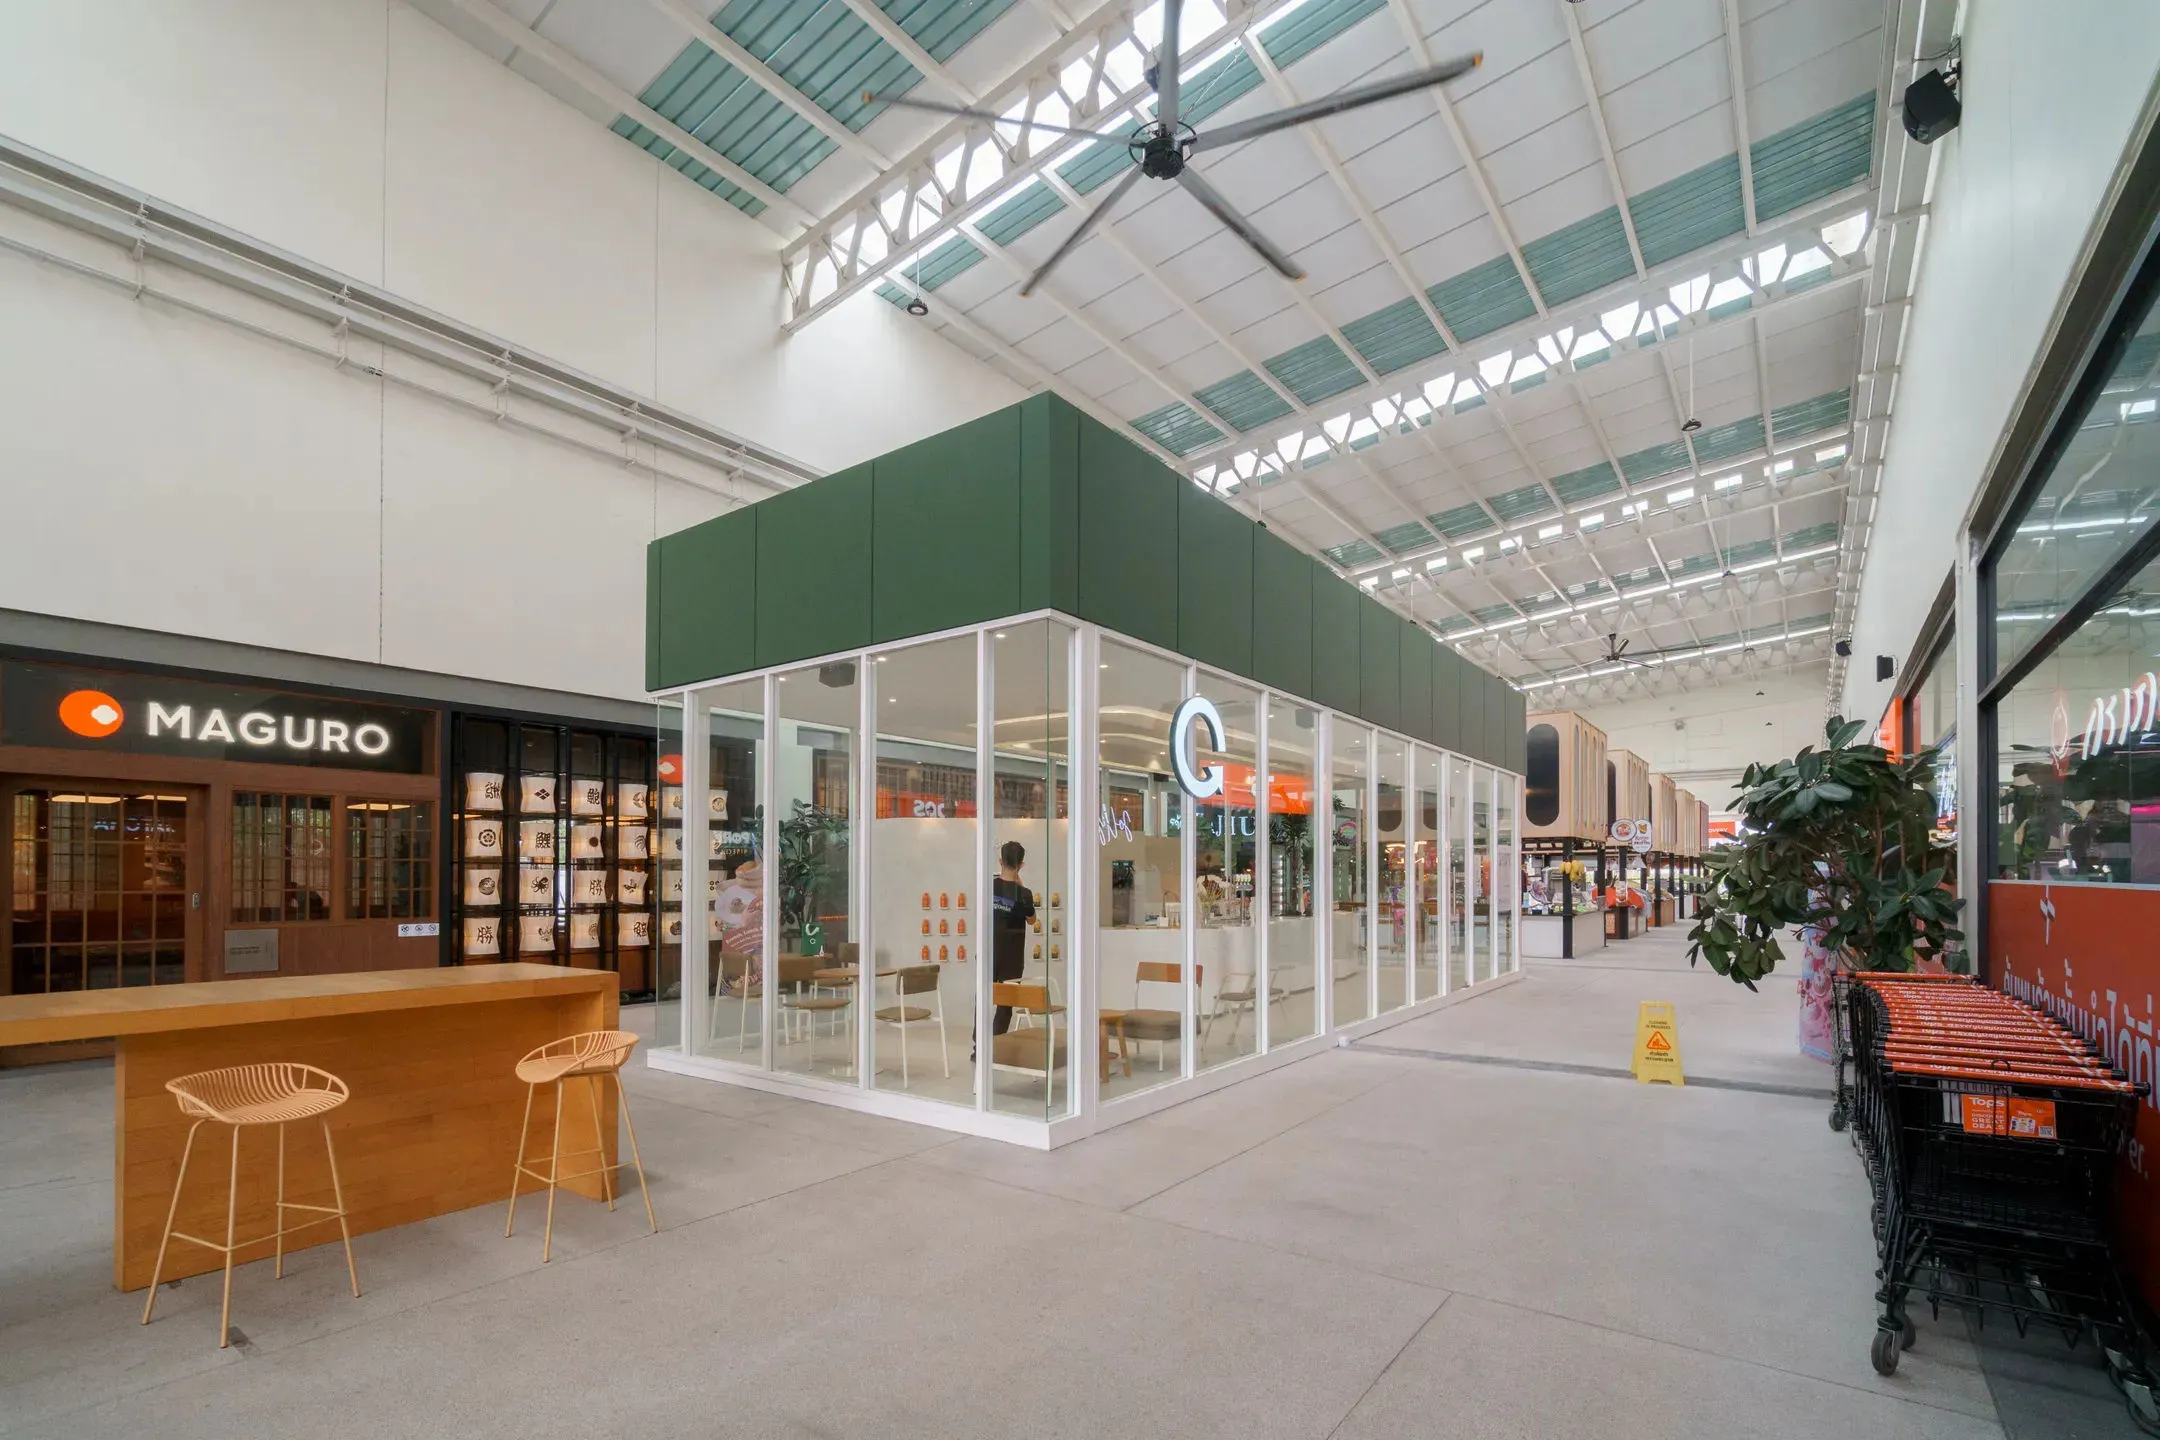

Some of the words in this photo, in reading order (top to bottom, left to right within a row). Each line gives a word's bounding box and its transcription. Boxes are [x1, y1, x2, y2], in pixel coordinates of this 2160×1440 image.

[148, 701, 390, 755] MAGURO
[1170, 696, 1226, 799] G
[477, 925, 494, 944] 勝
[1968, 1096, 2005, 1108] Tops
